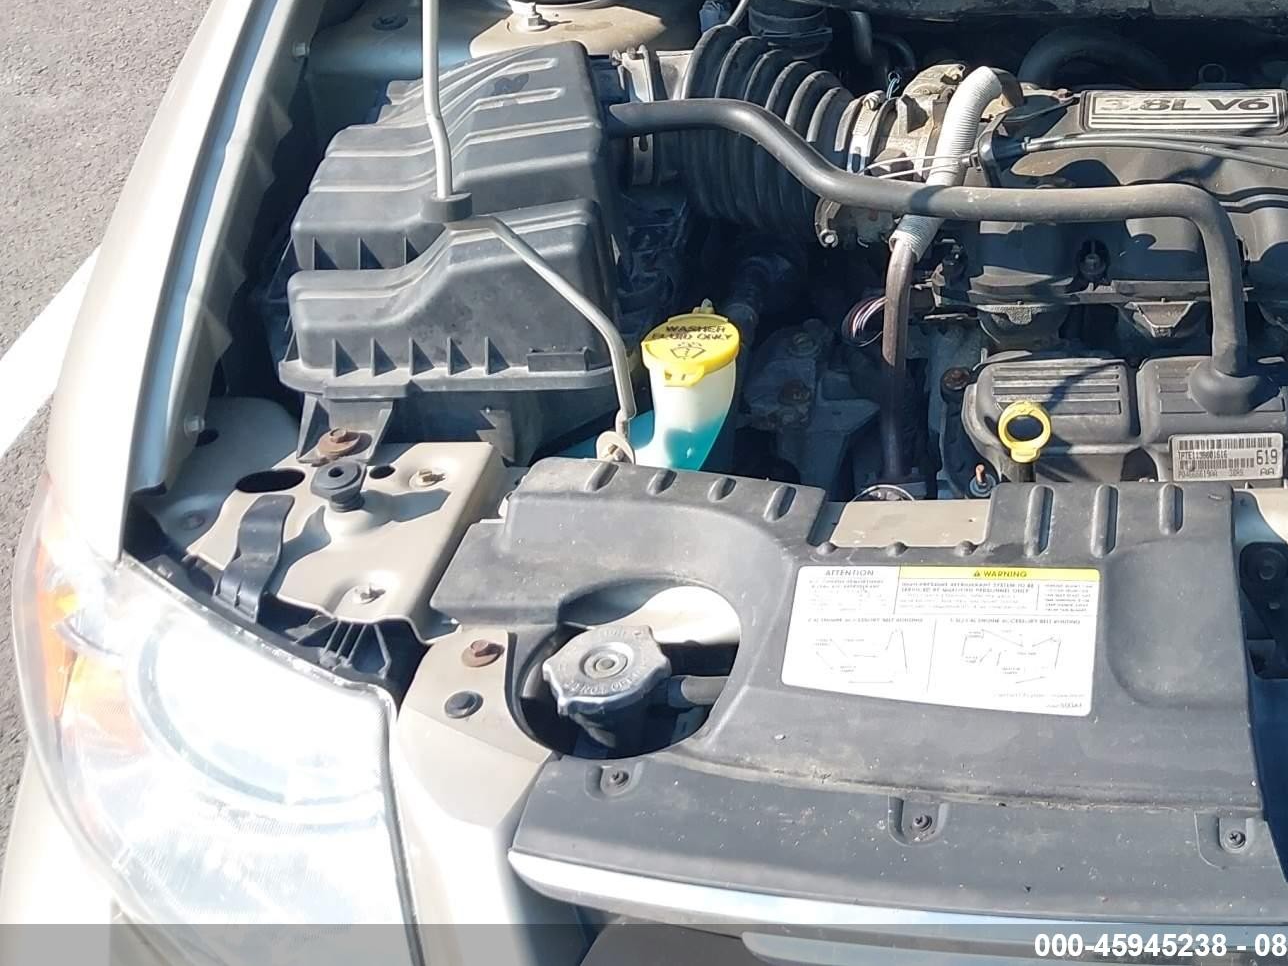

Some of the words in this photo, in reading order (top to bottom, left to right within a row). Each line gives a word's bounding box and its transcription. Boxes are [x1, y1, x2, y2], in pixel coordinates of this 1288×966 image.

[1100, 98, 1201, 111] 3.8L
[1207, 98, 1270, 111] V6
[666, 325, 726, 333] WASHER
[1256, 449, 1278, 465] 619
[1260, 467, 1275, 475] AA
[983, 570, 1028, 578] WARNING
